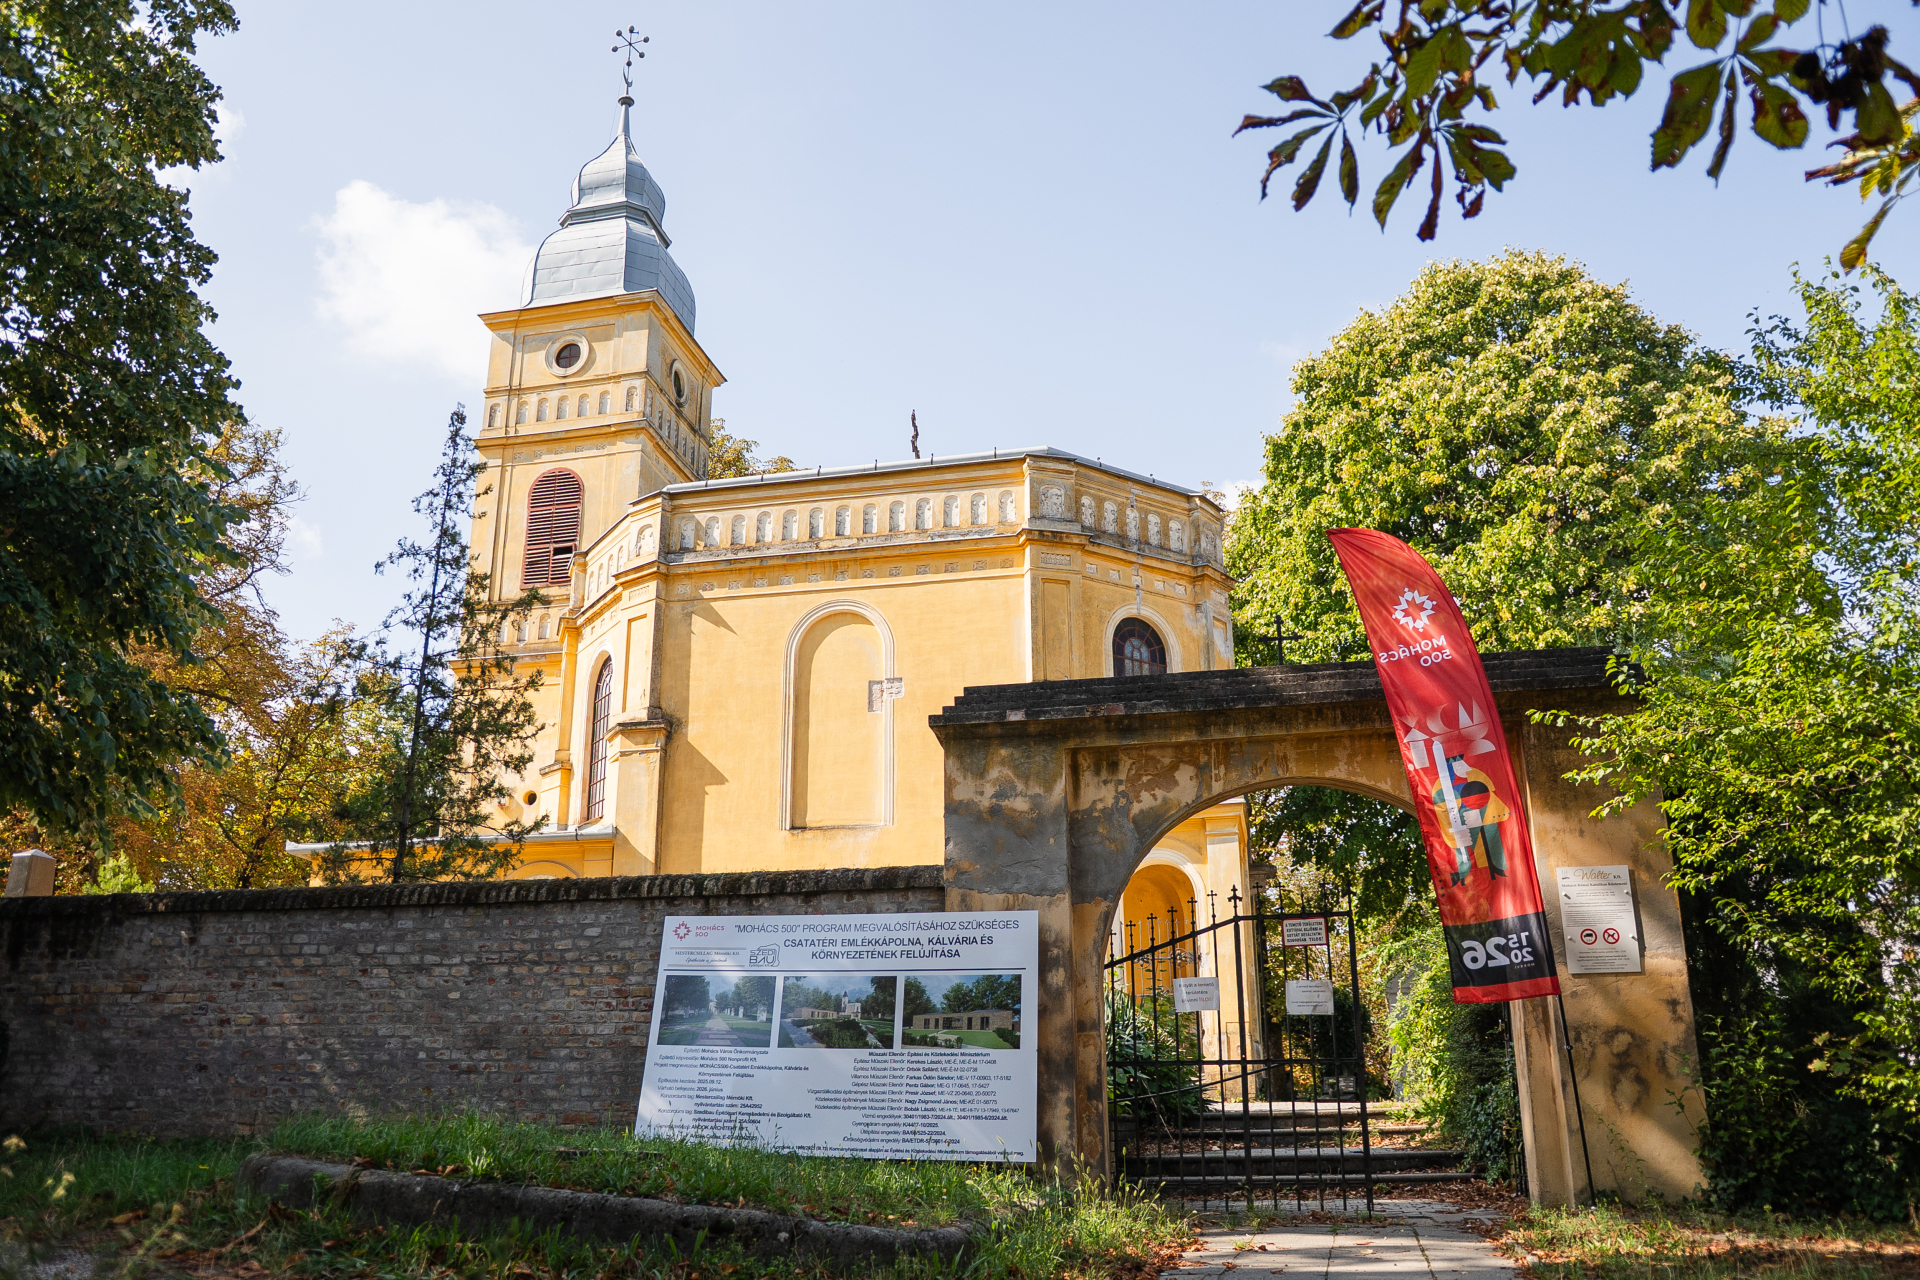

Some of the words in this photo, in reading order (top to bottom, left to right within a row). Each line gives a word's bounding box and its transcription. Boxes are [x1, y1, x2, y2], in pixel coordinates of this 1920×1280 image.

[1574, 869, 1612, 880] Walter
[735, 923, 779, 933] "MOHÁCS
[781, 924, 801, 933] 500"
[802, 923, 852, 932] PROGRAM
[854, 921, 957, 931] MEGVALÓSÍTÁSÁHOZ
[958, 920, 1020, 930] SZÜKSÉGES
[784, 937, 839, 948] CSATATÉRI
[840, 936, 926, 948] EMLÉKKÁPOLNA,
[928, 935, 979, 946] KÁLVÁRIA
[980, 935, 994, 945] ÉS
[811, 948, 898, 960] KÖRNYEZETÉNEK
[900, 947, 960, 958] FELÚJÍTÁSA
